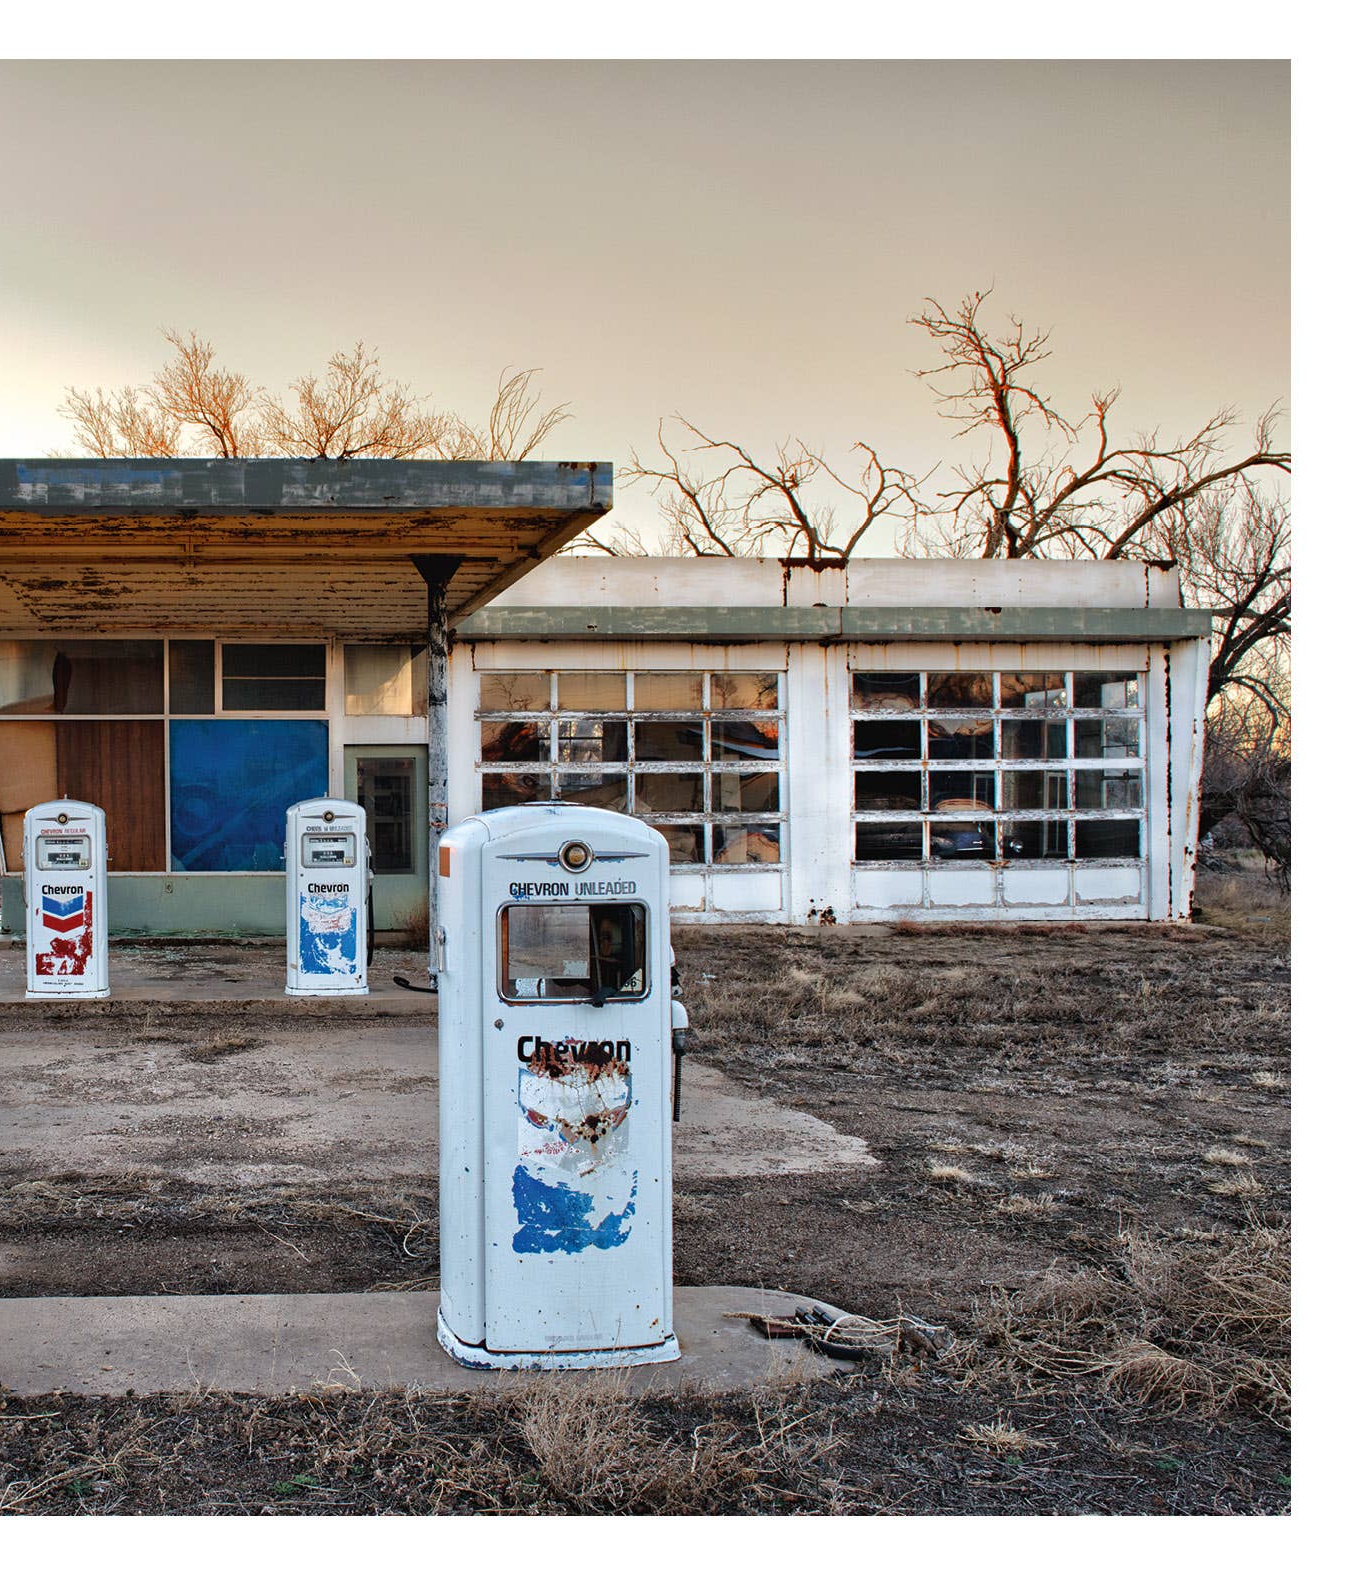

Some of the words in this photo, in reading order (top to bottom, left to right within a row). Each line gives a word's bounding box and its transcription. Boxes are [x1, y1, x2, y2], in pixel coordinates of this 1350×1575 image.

[42, 885, 84, 895] Chevron
[308, 883, 350, 894] Chevron
[509, 882, 569, 896] CHEVRON
[575, 881, 637, 895] UNLEADED
